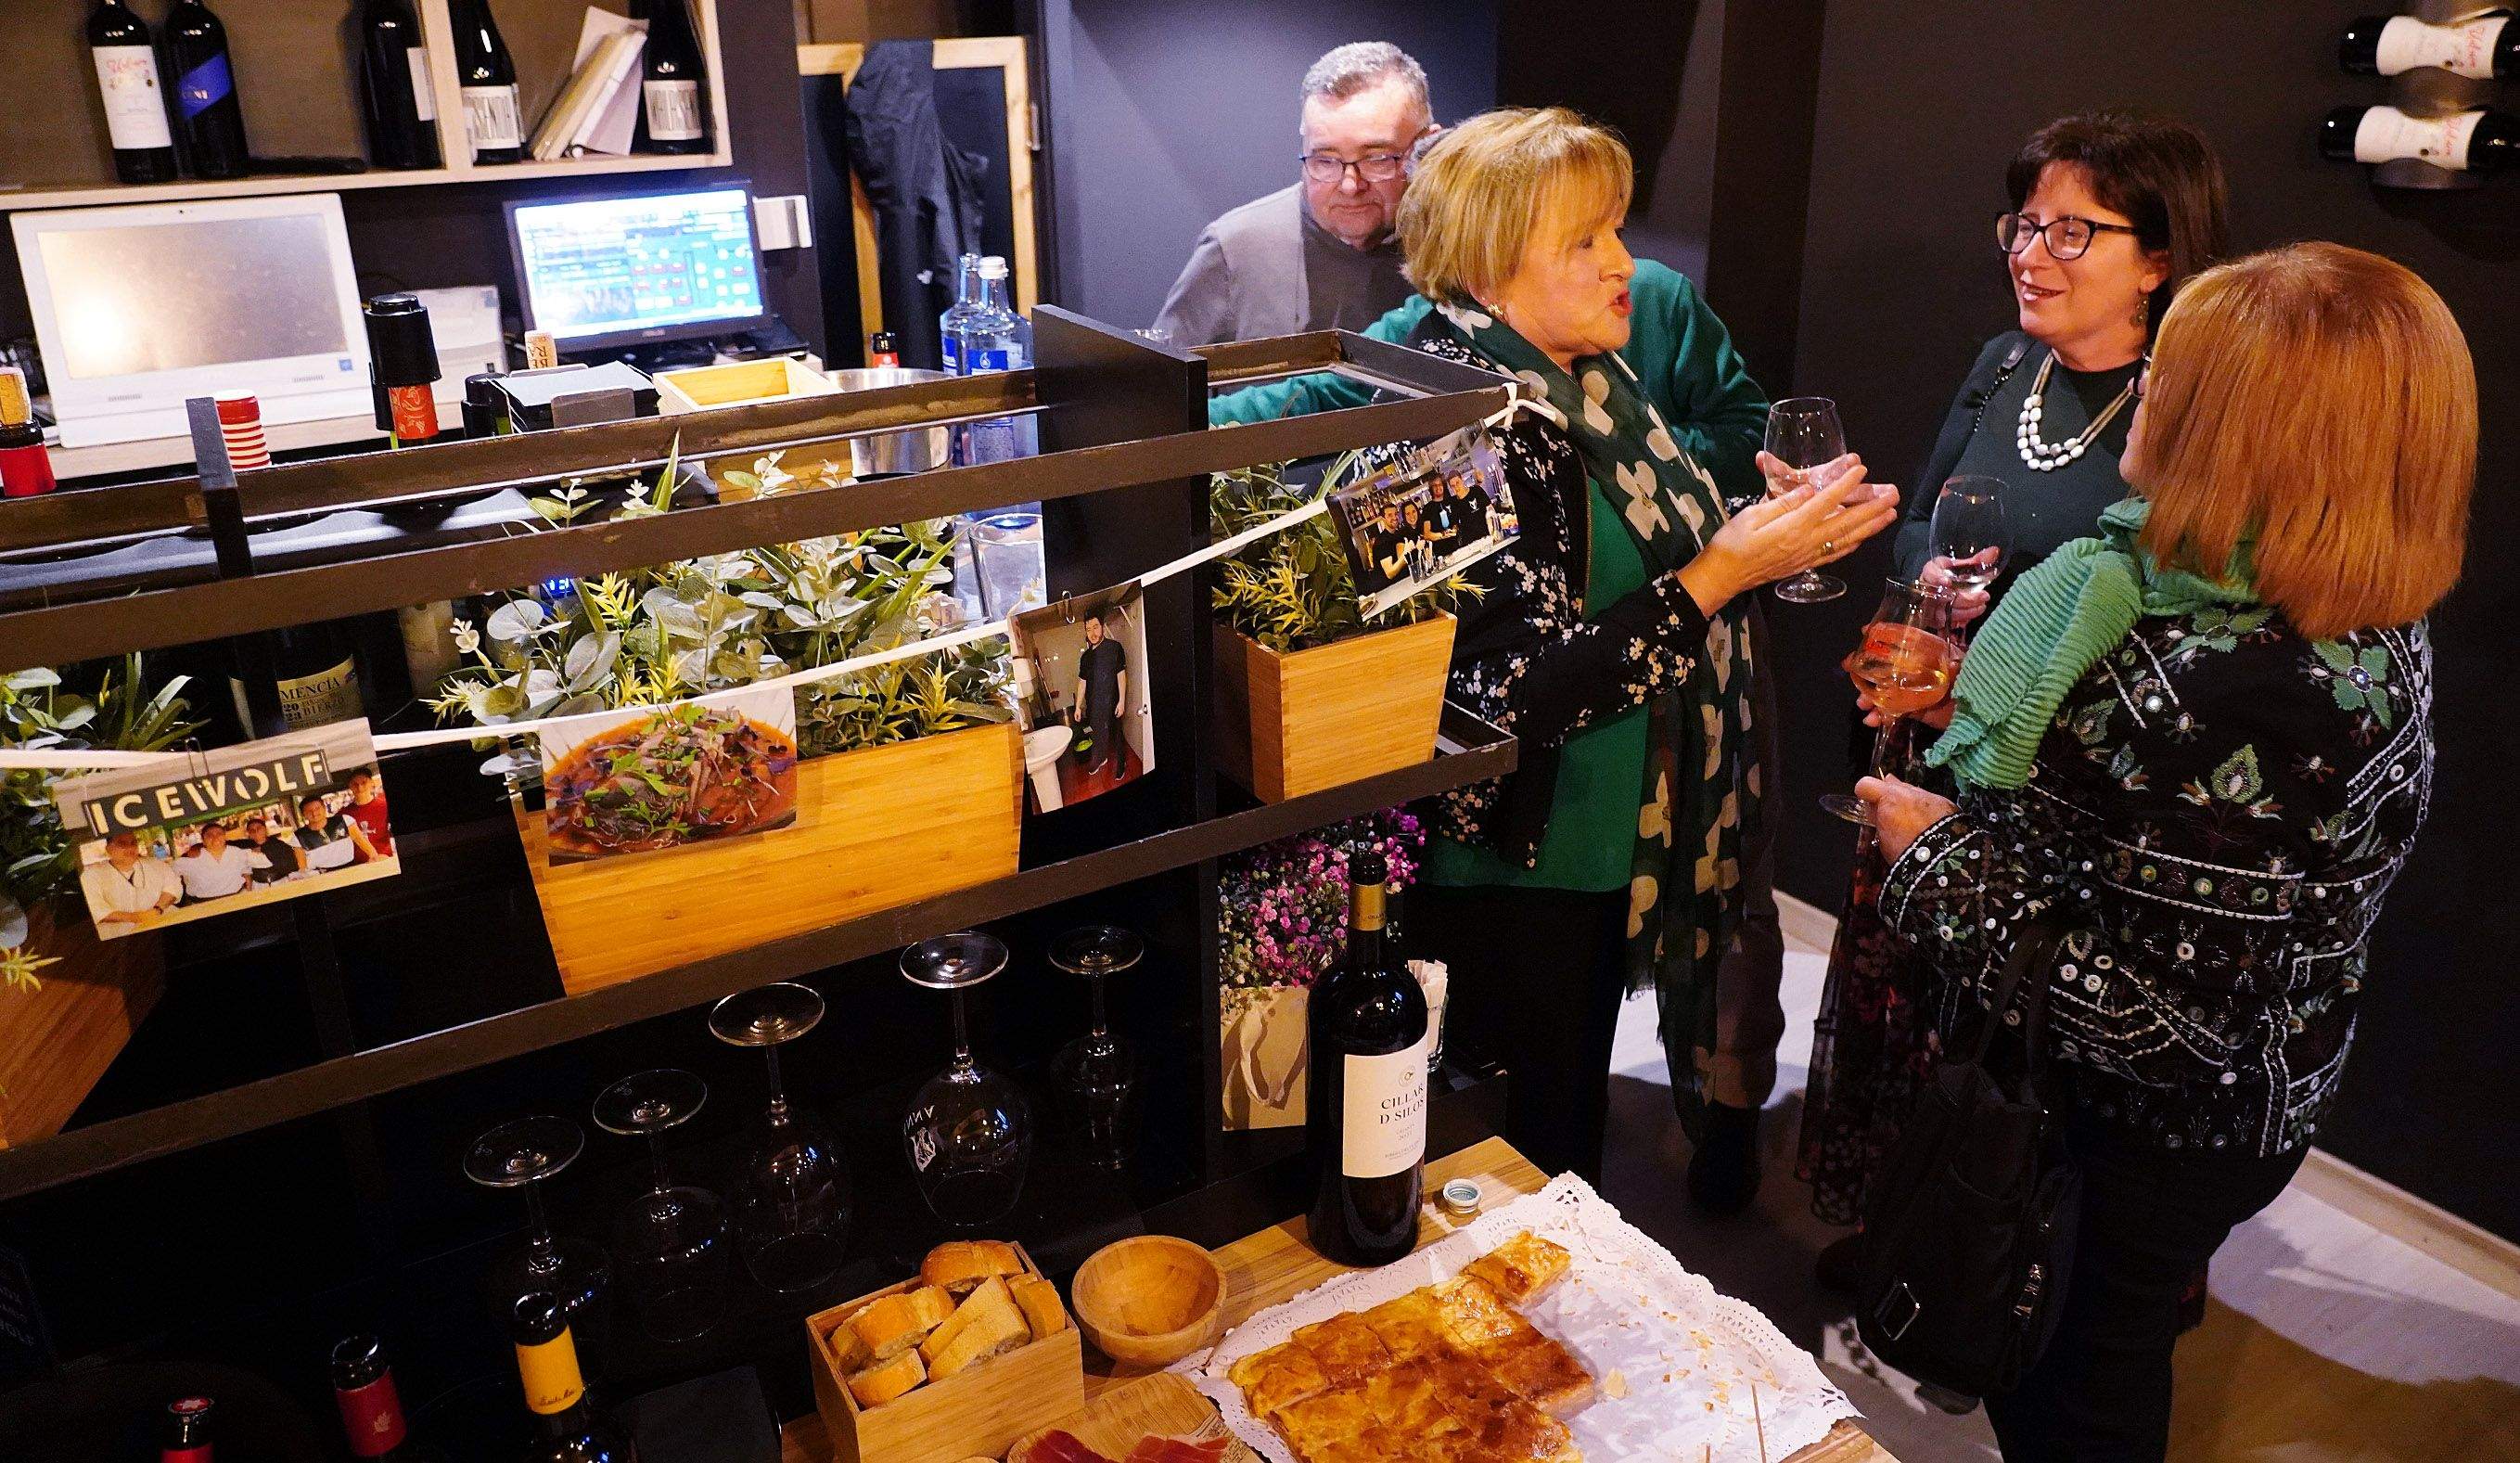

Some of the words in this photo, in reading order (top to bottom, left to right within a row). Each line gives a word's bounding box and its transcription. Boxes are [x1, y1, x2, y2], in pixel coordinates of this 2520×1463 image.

[90, 753, 325, 834] ICEWOLF
[1381, 1083, 1424, 1110] CILLAR
[1380, 1114, 1390, 1124] D
[1394, 1097, 1424, 1122] SILOS
